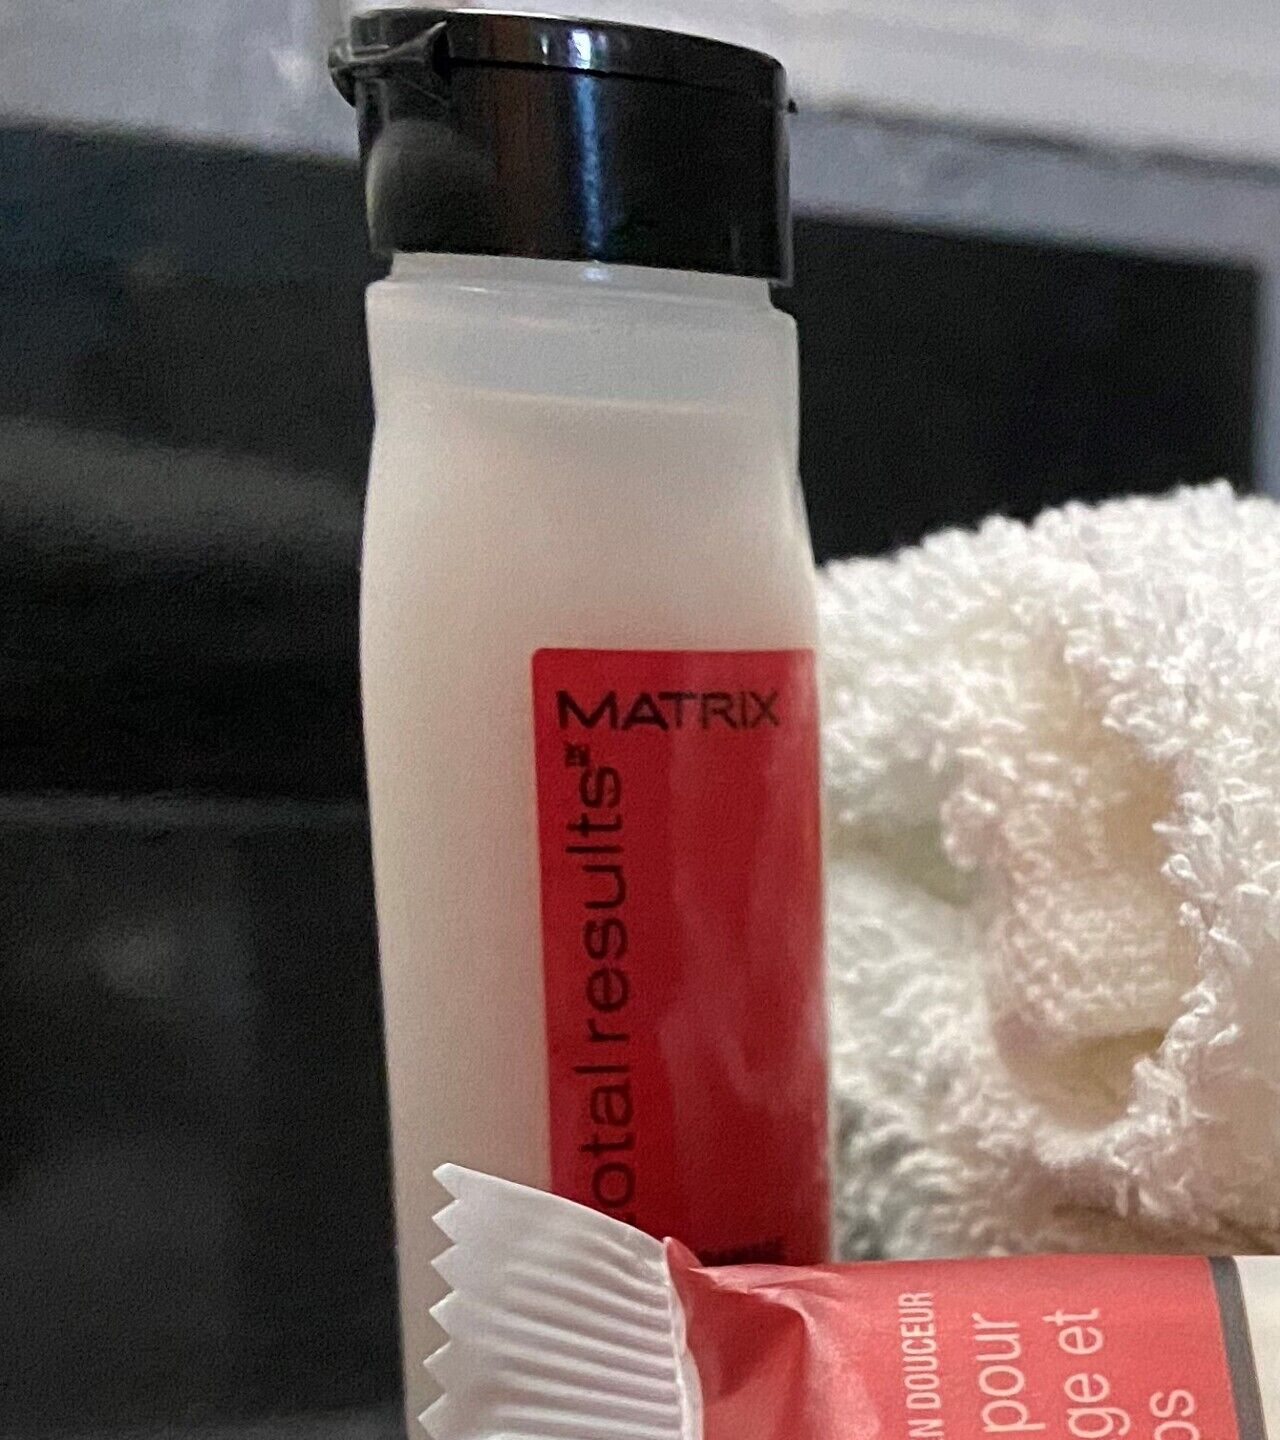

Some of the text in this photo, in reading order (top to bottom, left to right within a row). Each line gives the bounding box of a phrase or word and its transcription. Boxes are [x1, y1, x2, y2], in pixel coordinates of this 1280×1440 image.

[555, 689, 780, 731] MATRIX
[572, 1064, 636, 1222] otal
[899, 1291, 942, 1410] DOUCEUR
[971, 1312, 1046, 1433] pour
[1043, 1307, 1104, 1355] et
